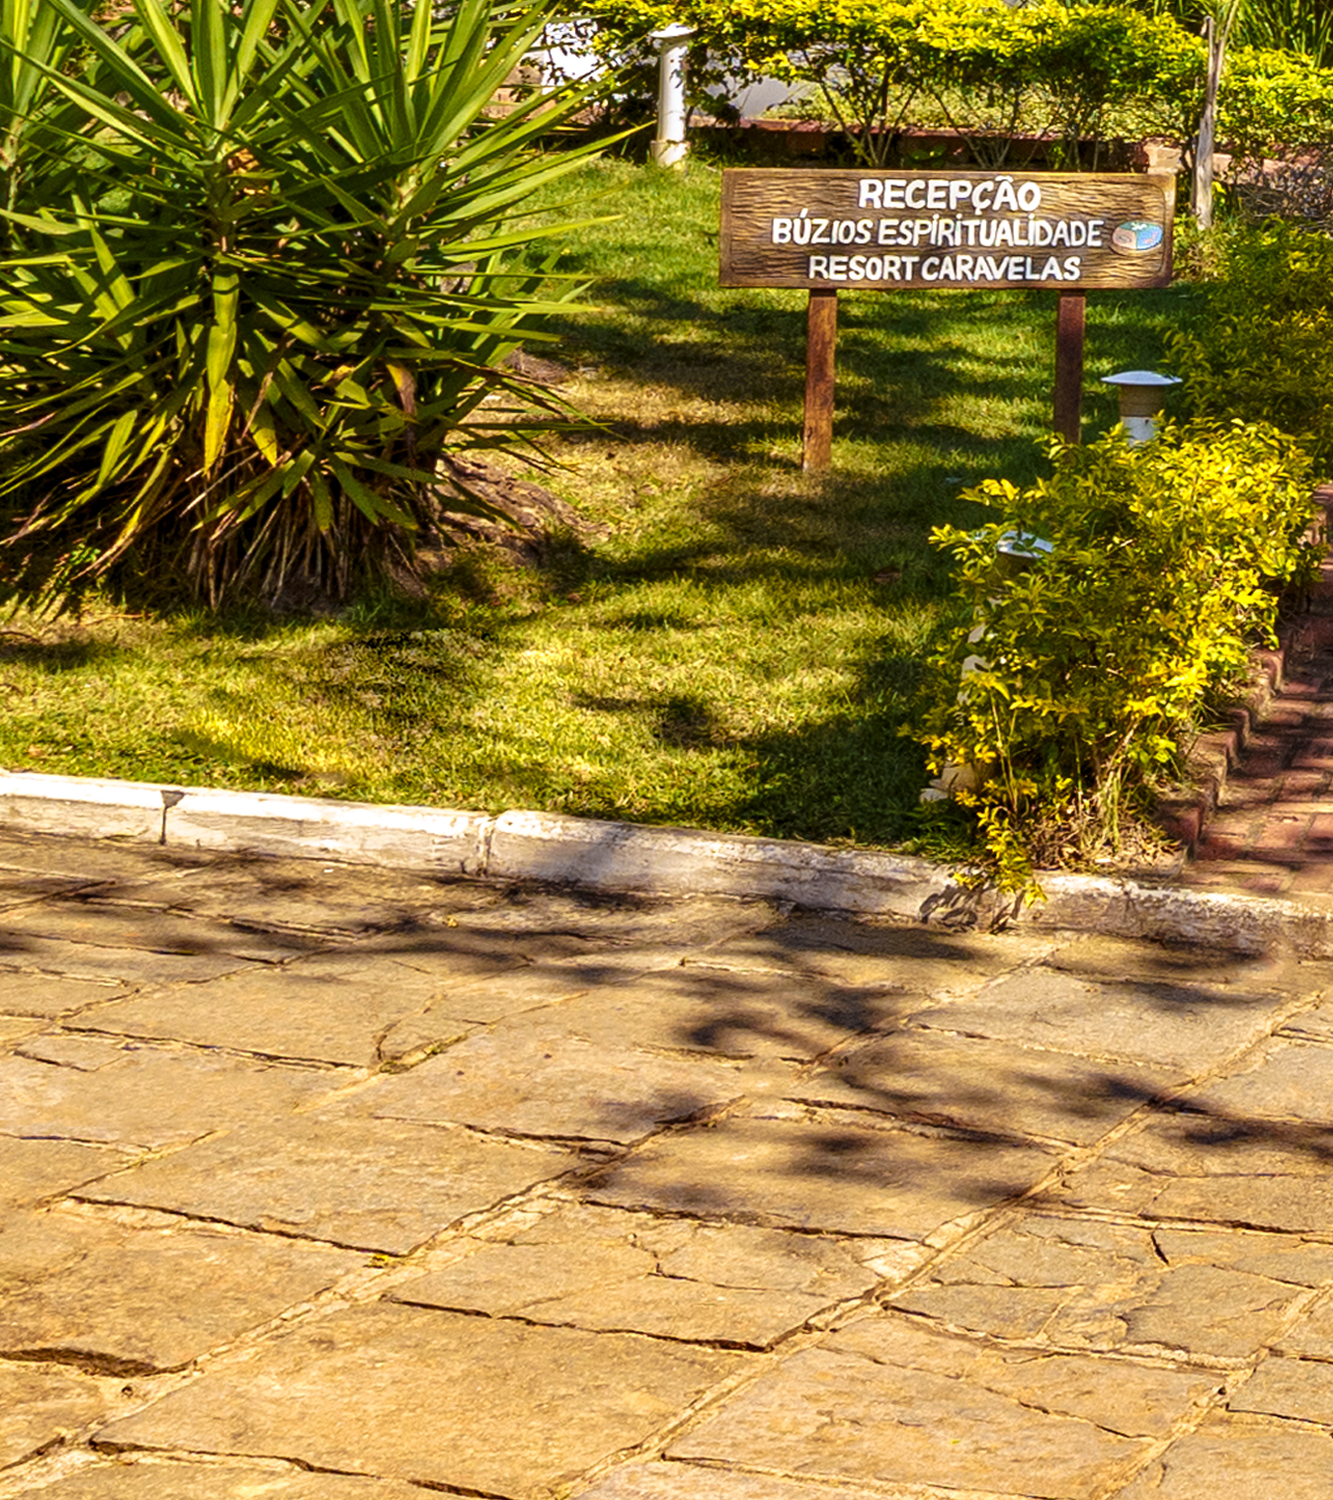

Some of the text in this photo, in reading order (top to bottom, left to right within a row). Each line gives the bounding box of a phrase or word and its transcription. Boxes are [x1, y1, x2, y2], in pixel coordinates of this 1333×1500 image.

[858, 176, 1042, 215] RECEPÇÃO
[772, 208, 873, 245] BÚZIOS
[808, 254, 1081, 281] RESORT CARAVELAS
